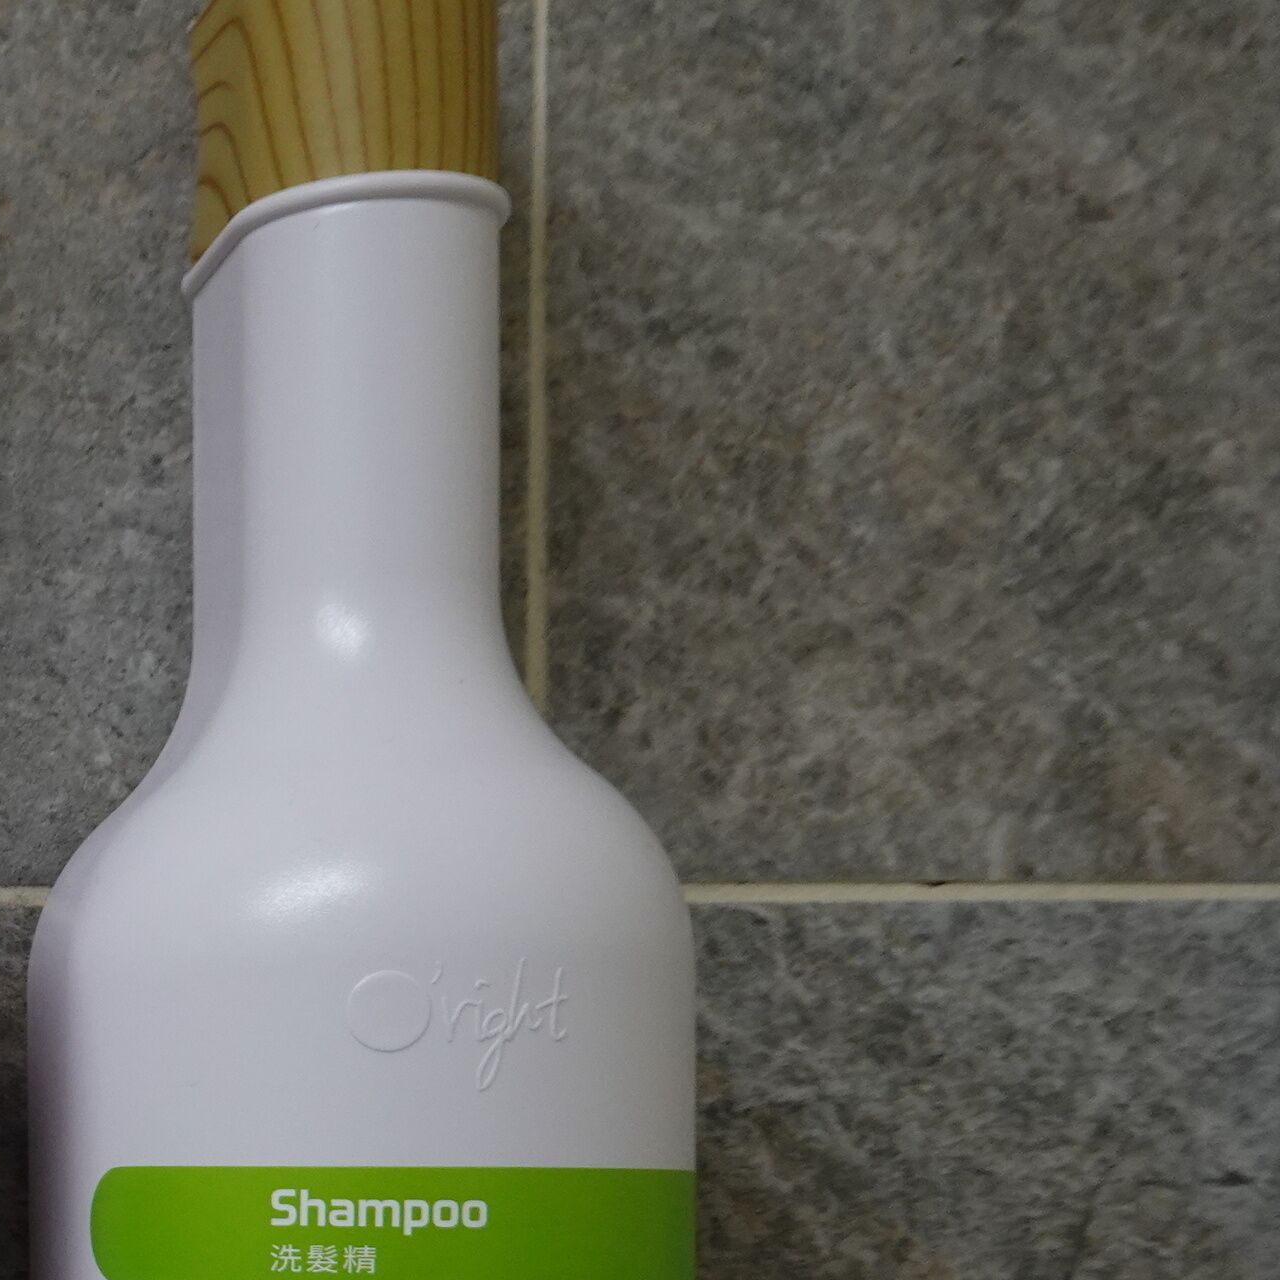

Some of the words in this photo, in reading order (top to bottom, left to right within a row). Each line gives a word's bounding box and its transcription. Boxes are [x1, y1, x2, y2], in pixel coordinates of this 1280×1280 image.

[348, 956, 568, 1092] O'right
[269, 1187, 489, 1237] Shampoo
[269, 1243, 378, 1276] 洗髮精
